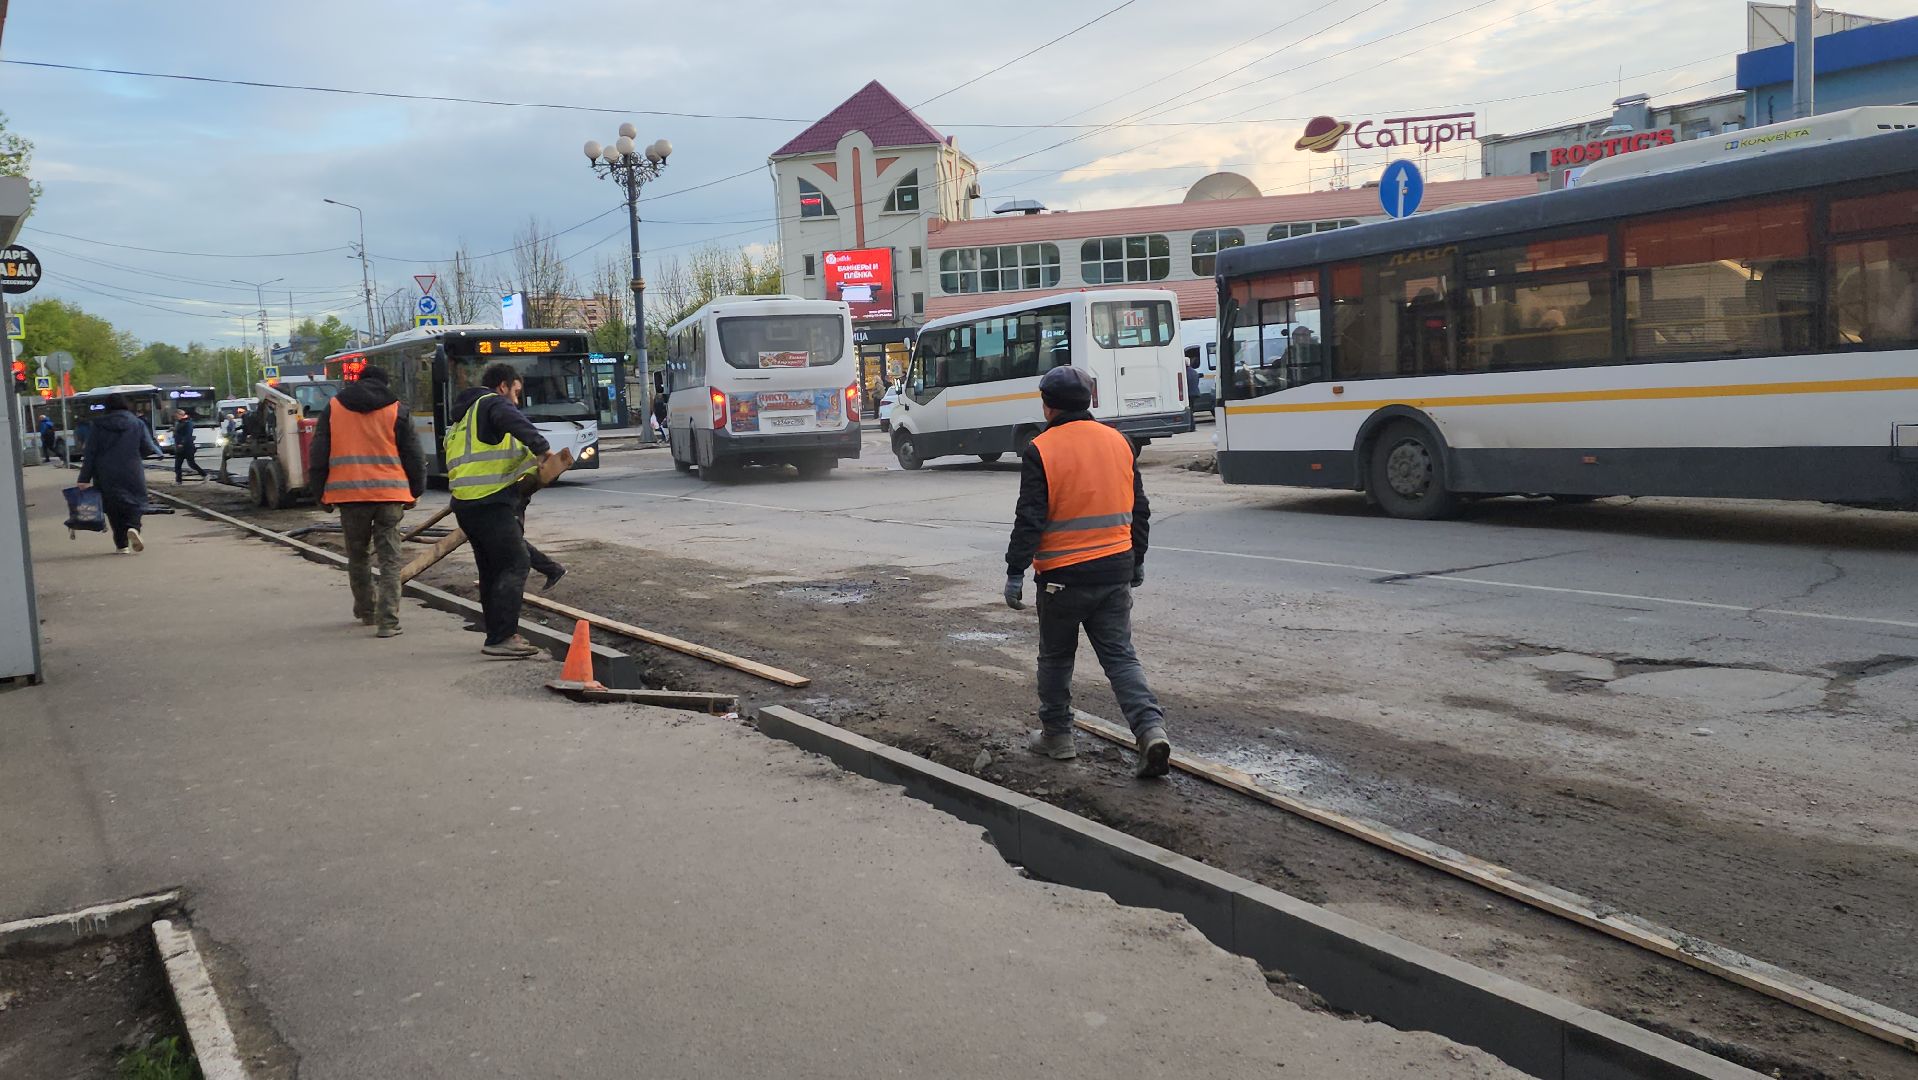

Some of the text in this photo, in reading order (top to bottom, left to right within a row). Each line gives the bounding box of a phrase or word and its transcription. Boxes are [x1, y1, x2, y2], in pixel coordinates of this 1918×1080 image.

[1740, 129, 1810, 148] KONVEKTA
[1550, 129, 1676, 167] ROSTIC'S
[837, 264, 872, 272] БАННЕРЫ
[843, 271, 873, 279] ПЛЁНКА
